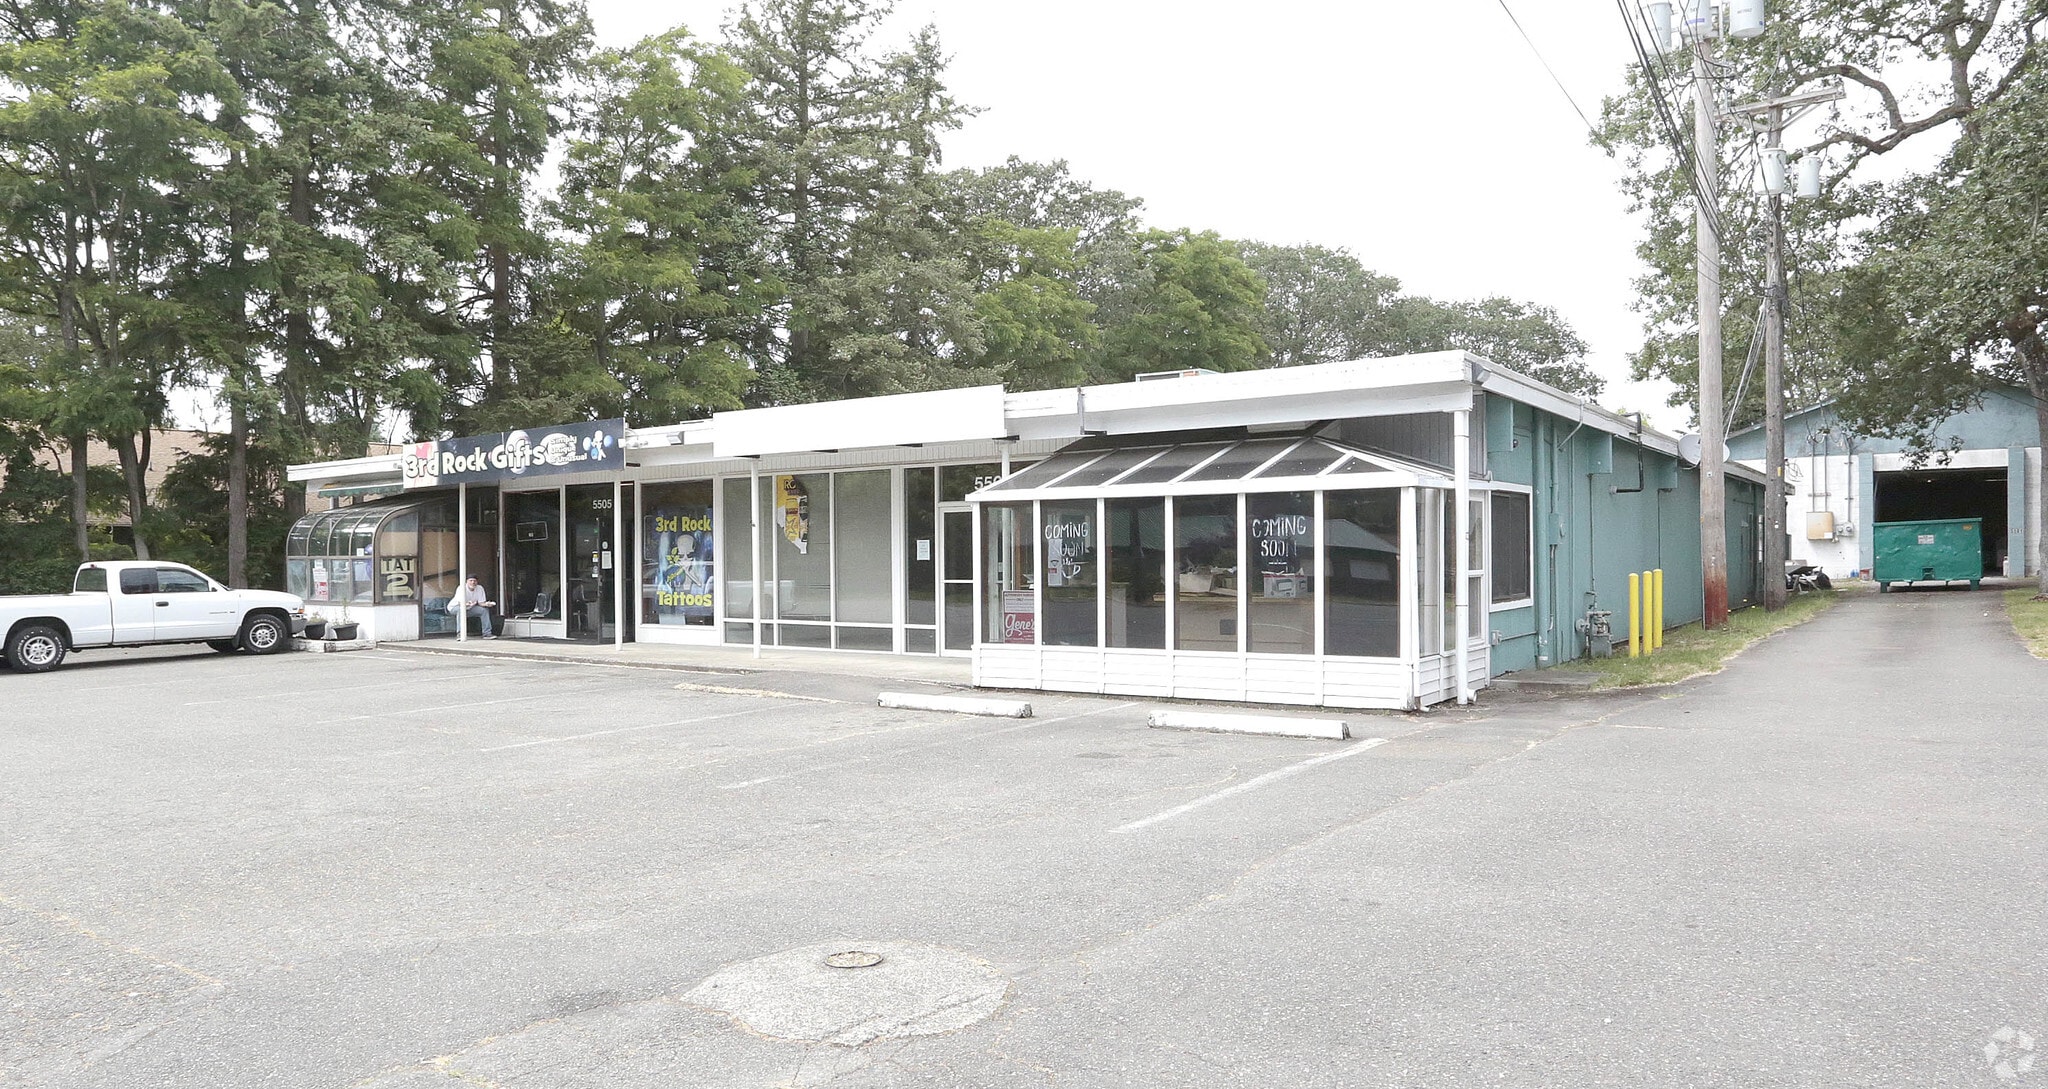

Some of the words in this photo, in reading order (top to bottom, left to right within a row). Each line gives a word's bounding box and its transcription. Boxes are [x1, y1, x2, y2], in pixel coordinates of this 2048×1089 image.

[405, 453, 440, 478] 3rd
[442, 446, 488, 476] Rock
[491, 438, 547, 470] Gifts
[592, 499, 613, 509] 5505
[655, 516, 677, 533] 3rd
[682, 515, 712, 532] Rock
[1044, 521, 1089, 540] COMING
[1252, 515, 1307, 538] COMING
[1261, 539, 1297, 557] SOON
[382, 558, 414, 573] TAT
[386, 573, 410, 592] 2
[656, 590, 713, 607] Tattoos
